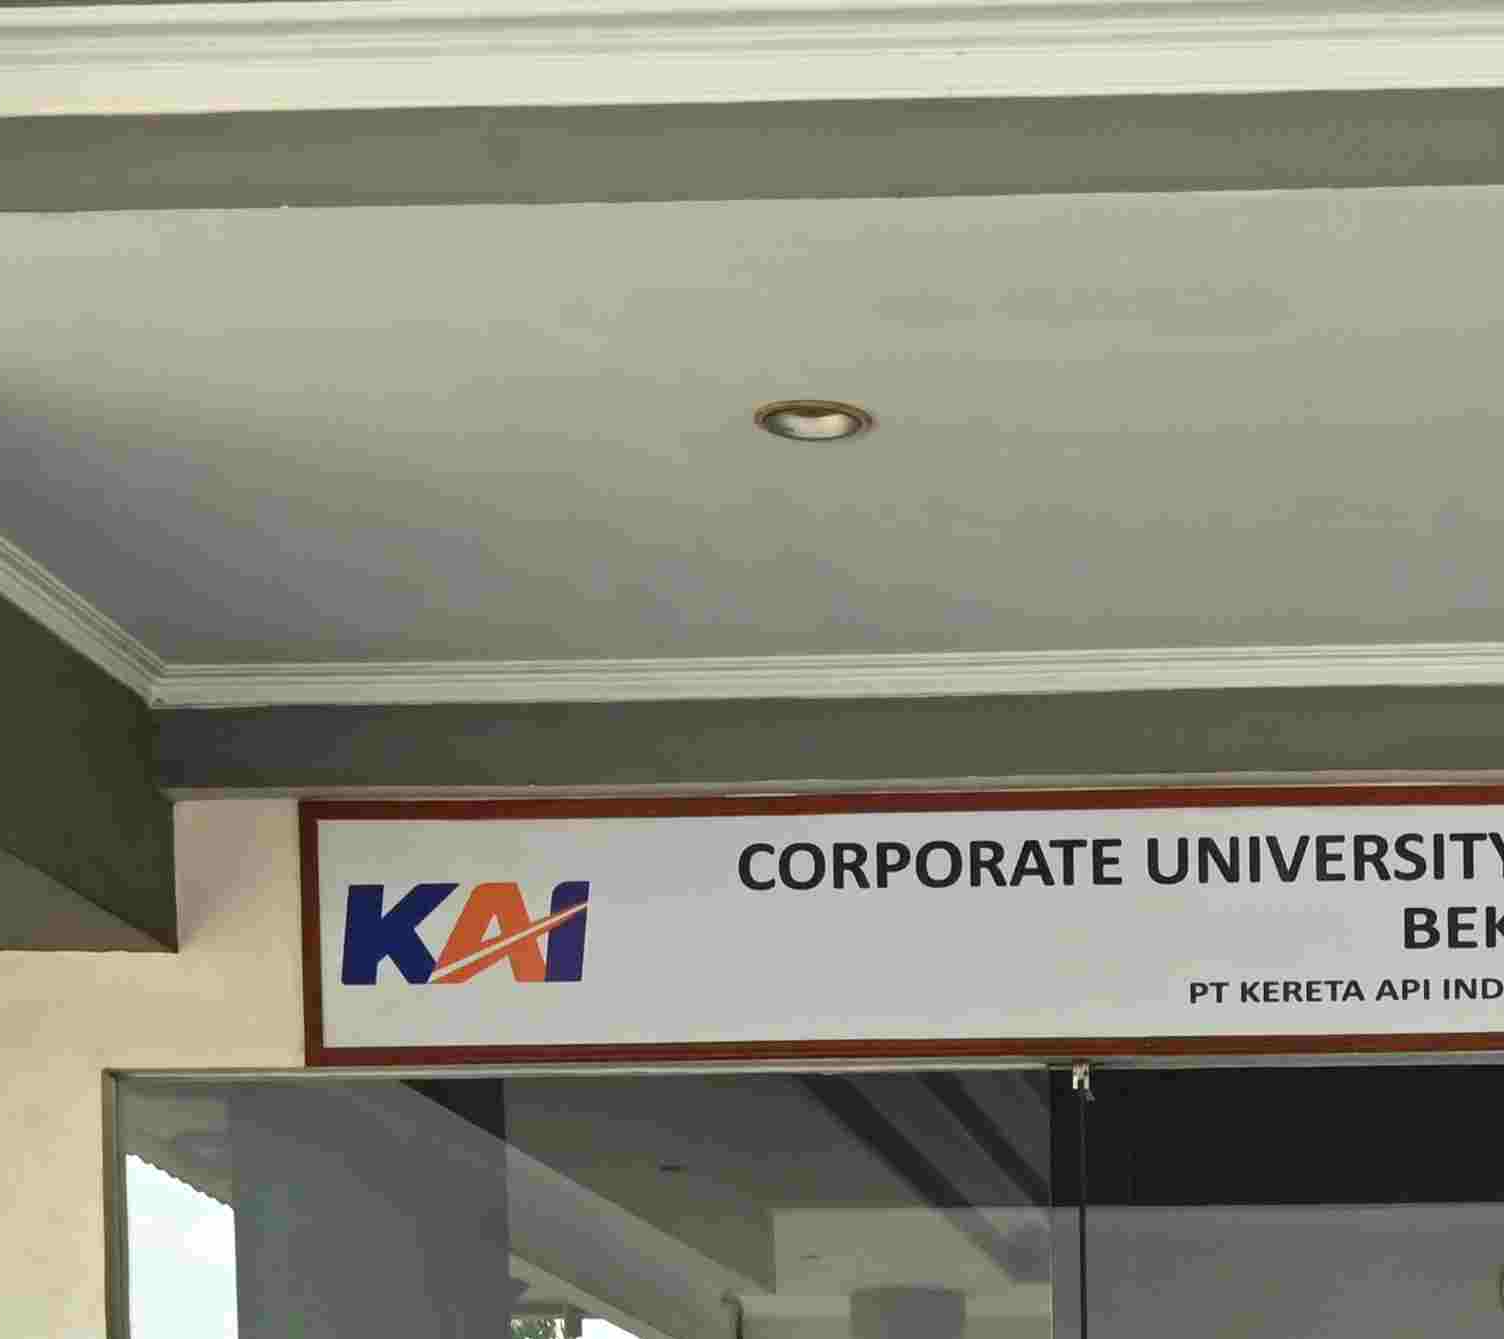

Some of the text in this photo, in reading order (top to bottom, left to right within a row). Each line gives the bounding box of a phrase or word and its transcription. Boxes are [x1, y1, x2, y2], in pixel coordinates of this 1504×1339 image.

[738, 838, 1123, 891] CORPORATE
[340, 880, 591, 986] KAI
[1190, 982, 1230, 1004] PT
[1240, 980, 1364, 1003] KERETA
[1375, 979, 1430, 1001] API
